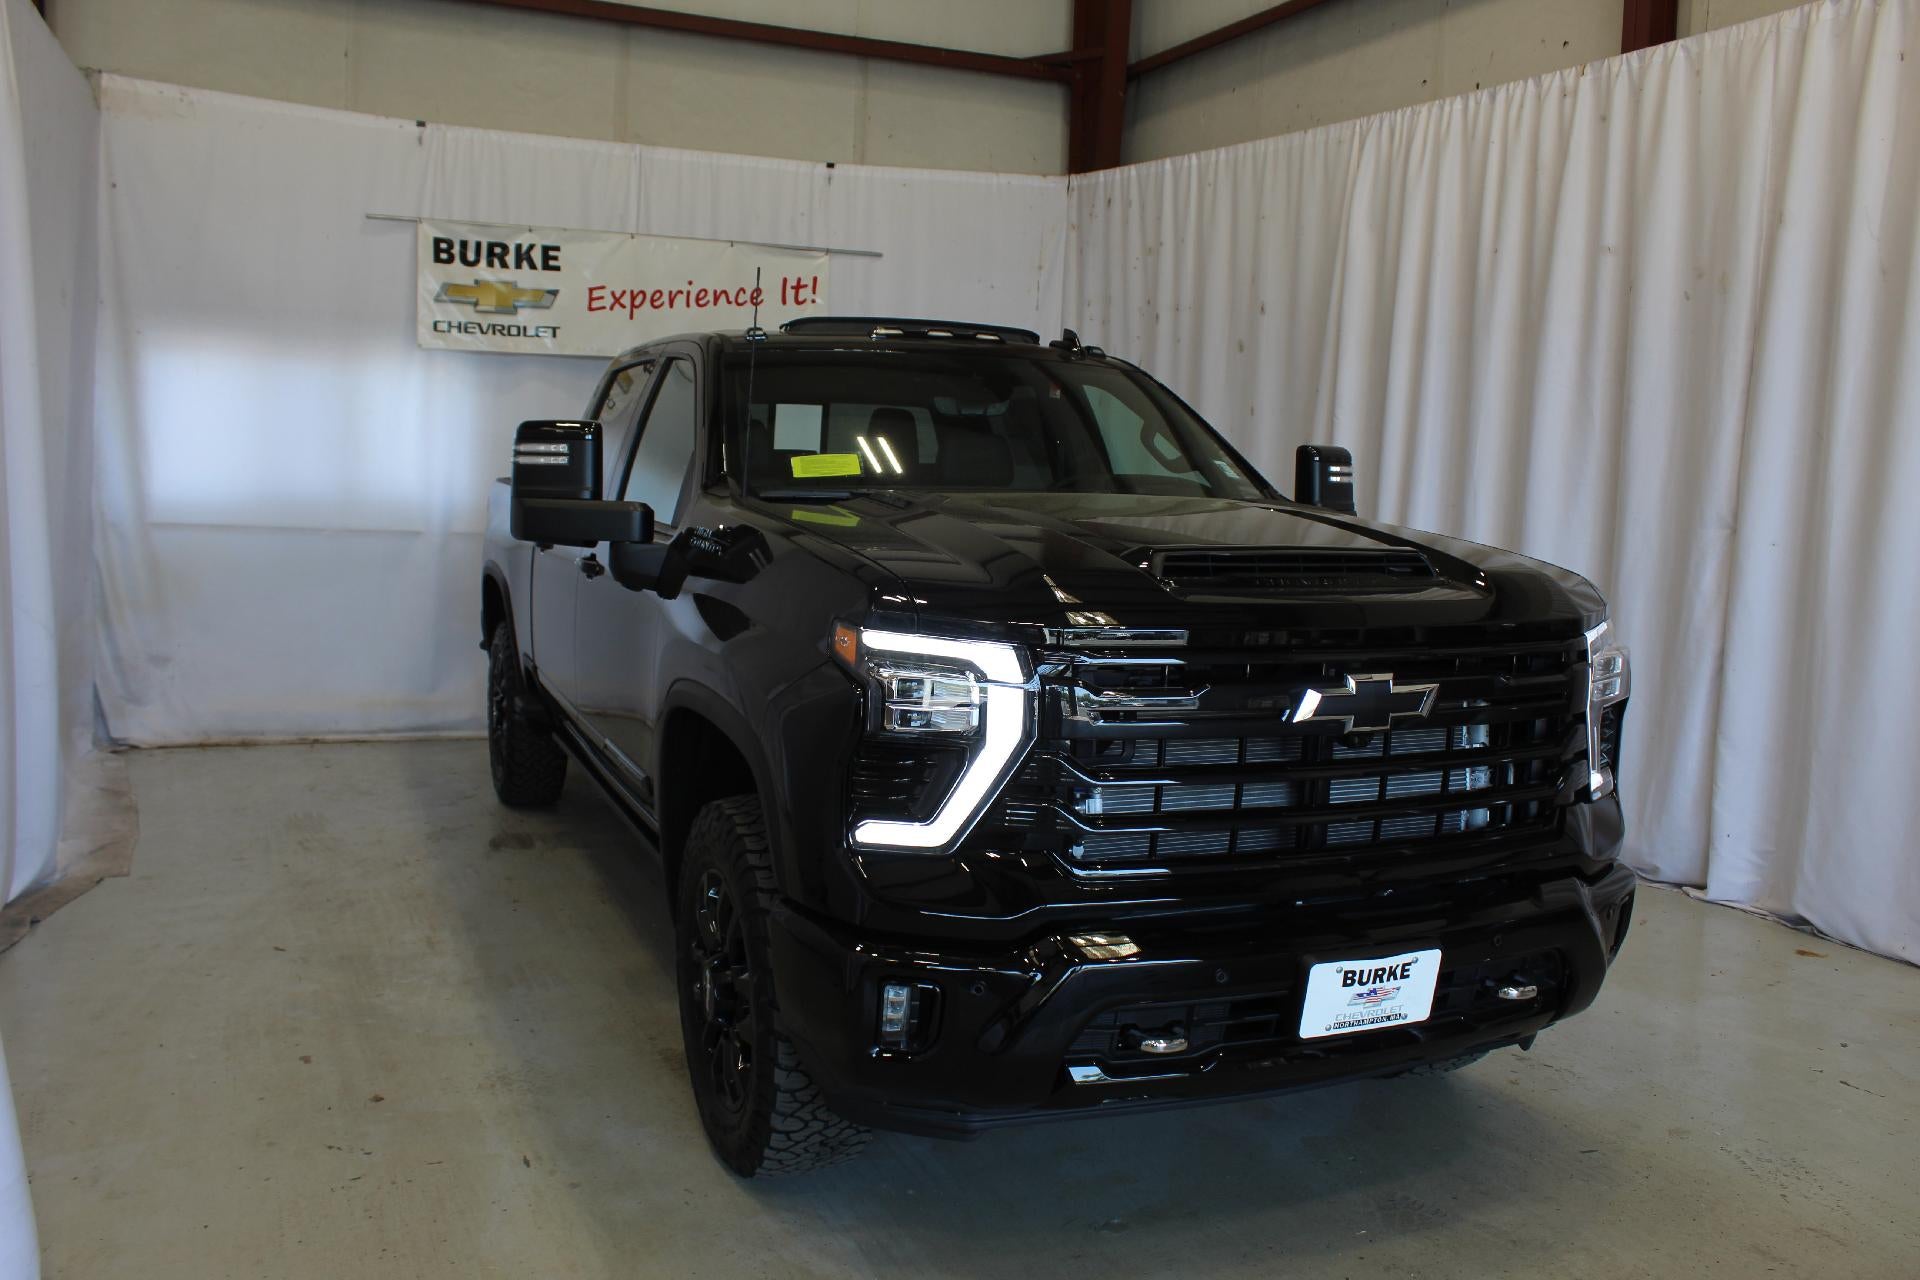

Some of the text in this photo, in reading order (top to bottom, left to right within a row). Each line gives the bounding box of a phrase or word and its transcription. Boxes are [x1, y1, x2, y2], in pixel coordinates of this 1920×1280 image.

[432, 236, 561, 272] BURKE
[587, 275, 819, 319] Experience It!
[432, 319, 561, 339] CHEVROLET
[1342, 962, 1412, 987] BURKE
[1335, 1005, 1404, 1021] CHEVROLET
